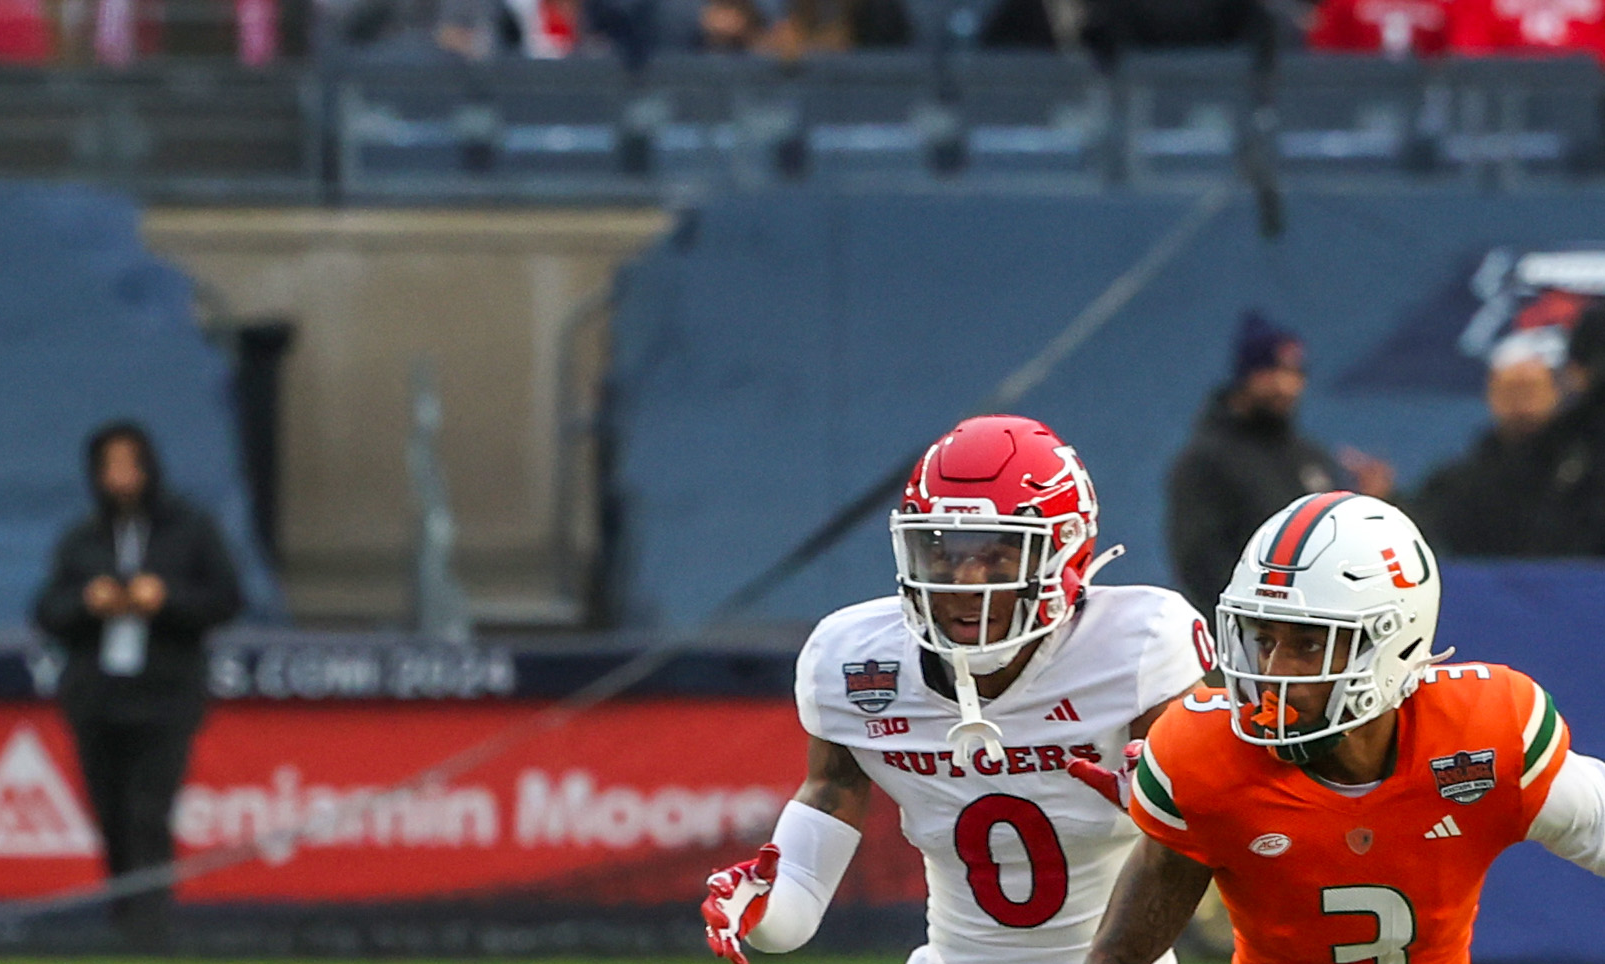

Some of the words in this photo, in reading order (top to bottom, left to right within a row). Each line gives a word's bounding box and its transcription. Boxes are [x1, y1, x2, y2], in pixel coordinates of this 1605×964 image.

[1192, 618, 1213, 672] 0
[172, 765, 500, 866] enjamin
[954, 793, 1068, 928] 0
